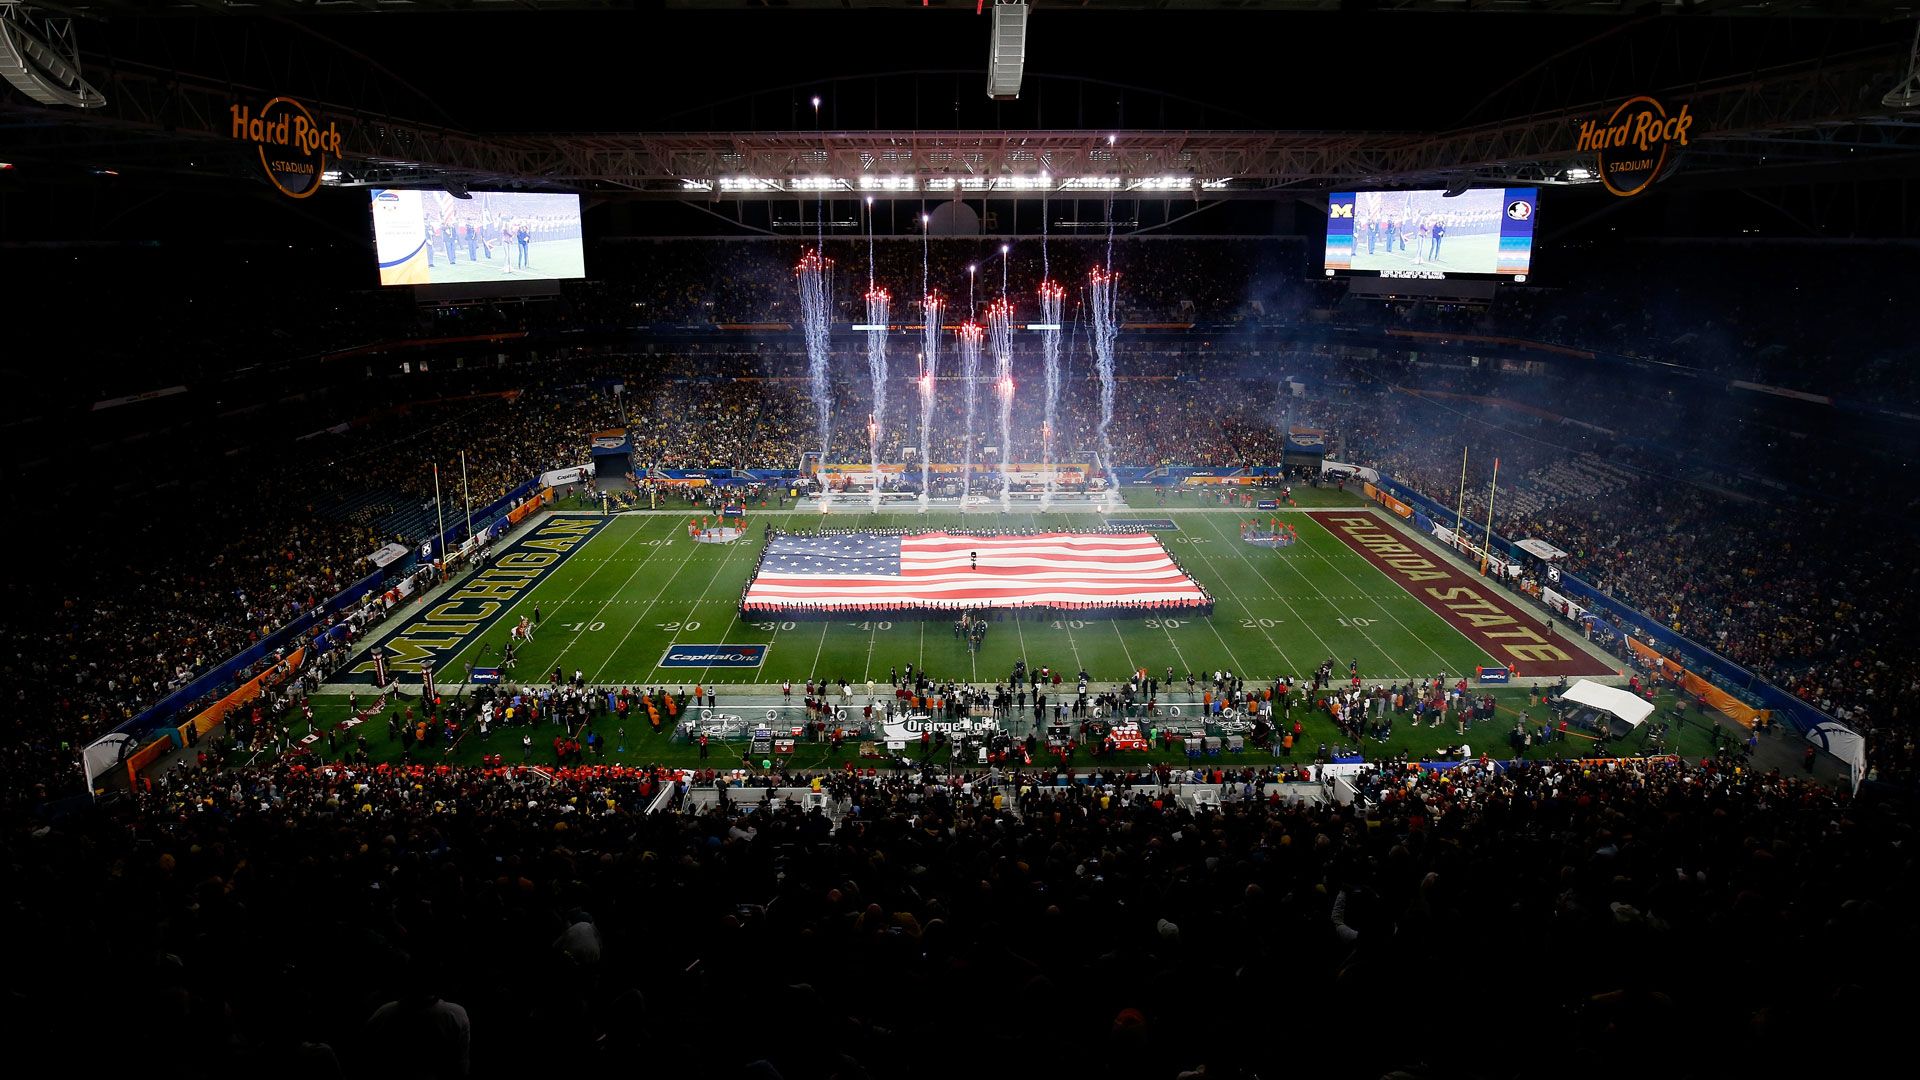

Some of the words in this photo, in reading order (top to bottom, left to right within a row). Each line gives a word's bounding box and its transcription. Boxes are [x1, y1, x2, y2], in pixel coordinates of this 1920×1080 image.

[230, 104, 289, 146] Hard
[294, 115, 343, 160] Rock
[1576, 113, 1632, 152] Hard
[1632, 104, 1693, 152] Rock
[274, 160, 314, 175] STADIUM
[1609, 160, 1651, 173] STADIUM
[1330, 203, 1353, 219] M
[349, 519, 603, 675] MICHIGAN
[1328, 517, 1452, 582] FLORIDA
[1425, 587, 1574, 661] STATE
[669, 653, 759, 662] CapitalOne
